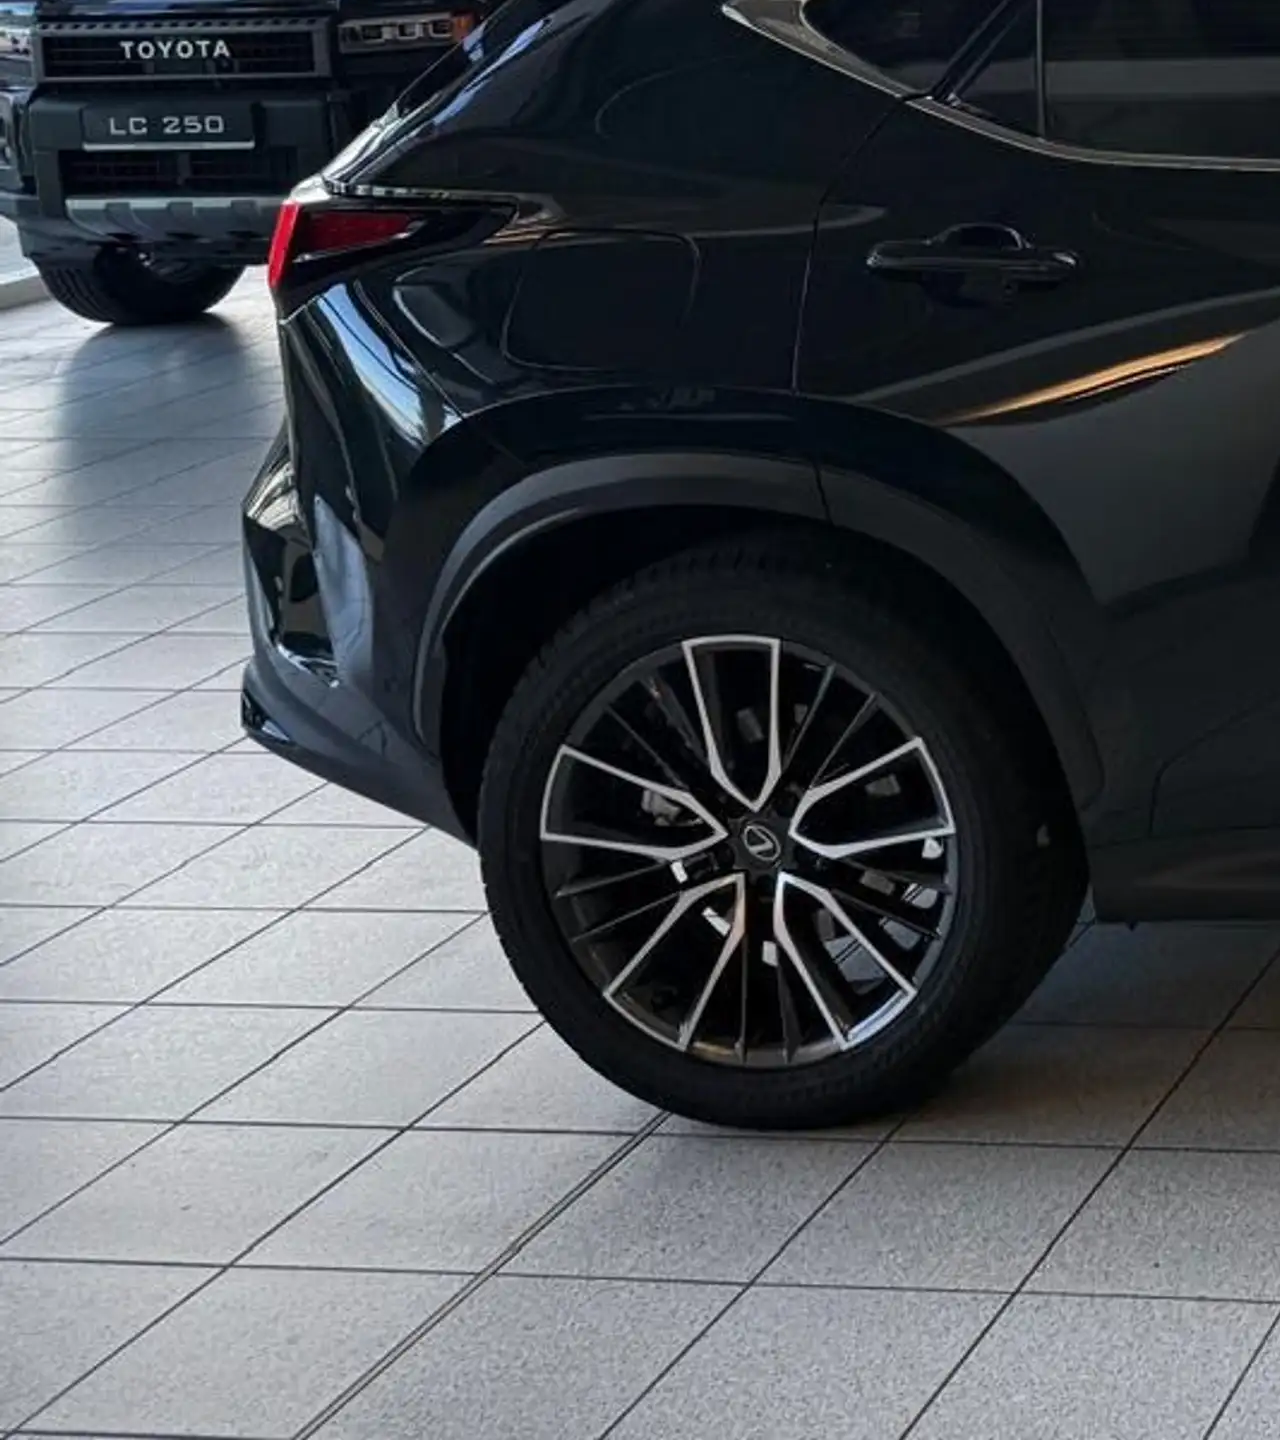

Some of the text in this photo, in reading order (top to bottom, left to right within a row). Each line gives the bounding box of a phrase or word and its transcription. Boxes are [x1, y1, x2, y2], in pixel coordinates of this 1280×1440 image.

[119, 40, 231, 59] TOYOTA
[110, 115, 225, 135] LC 250
